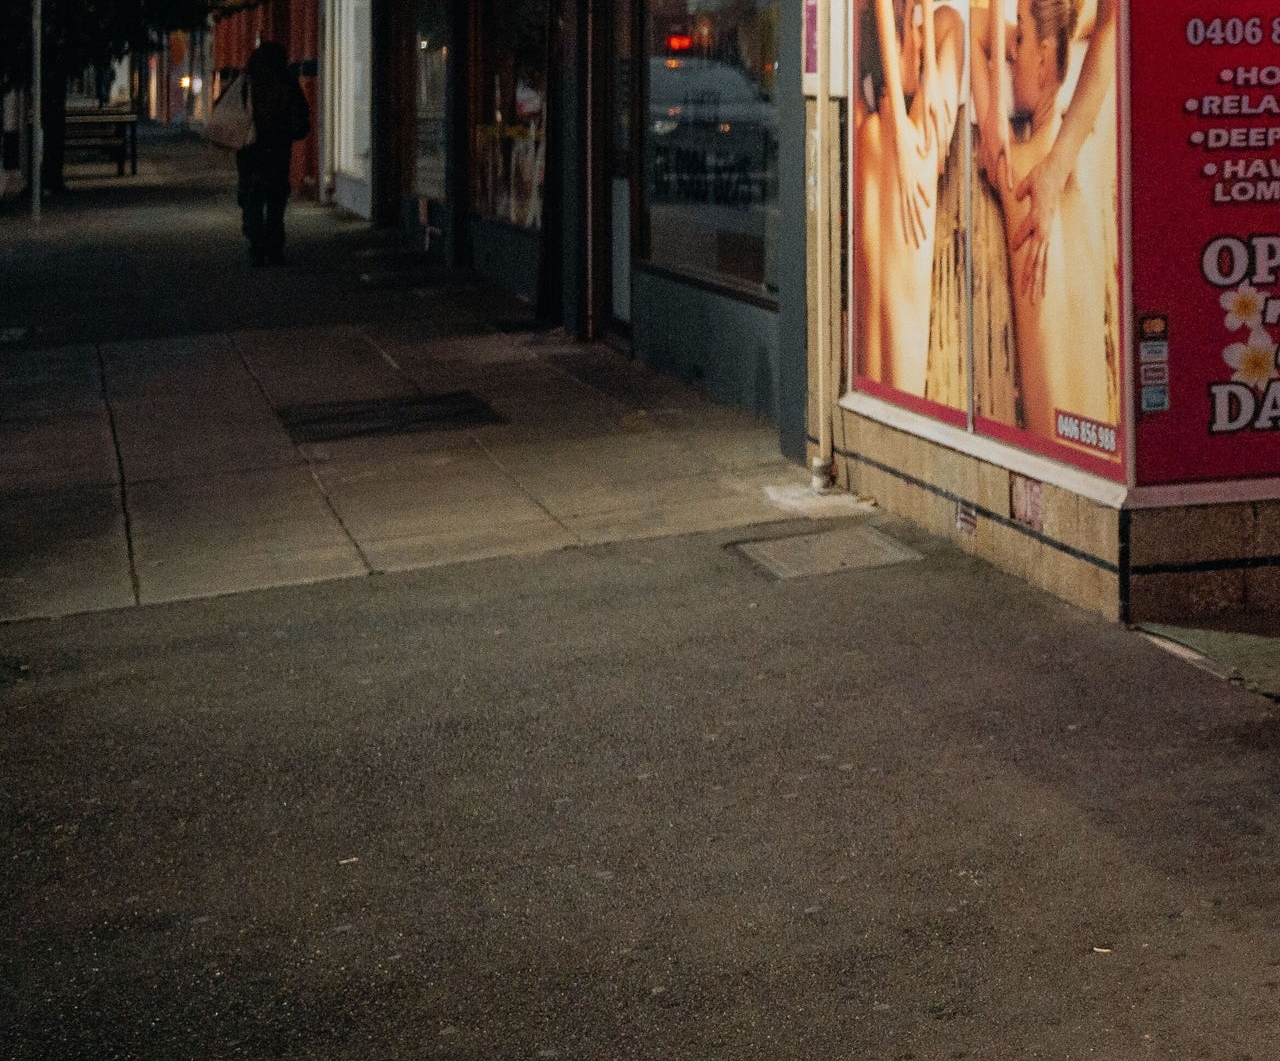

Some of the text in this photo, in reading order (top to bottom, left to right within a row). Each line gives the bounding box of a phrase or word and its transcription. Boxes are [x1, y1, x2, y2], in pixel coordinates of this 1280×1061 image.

[1186, 17, 1263, 46] 0406
[1057, 414, 1079, 439] 0406
[1080, 421, 1098, 446] 856
